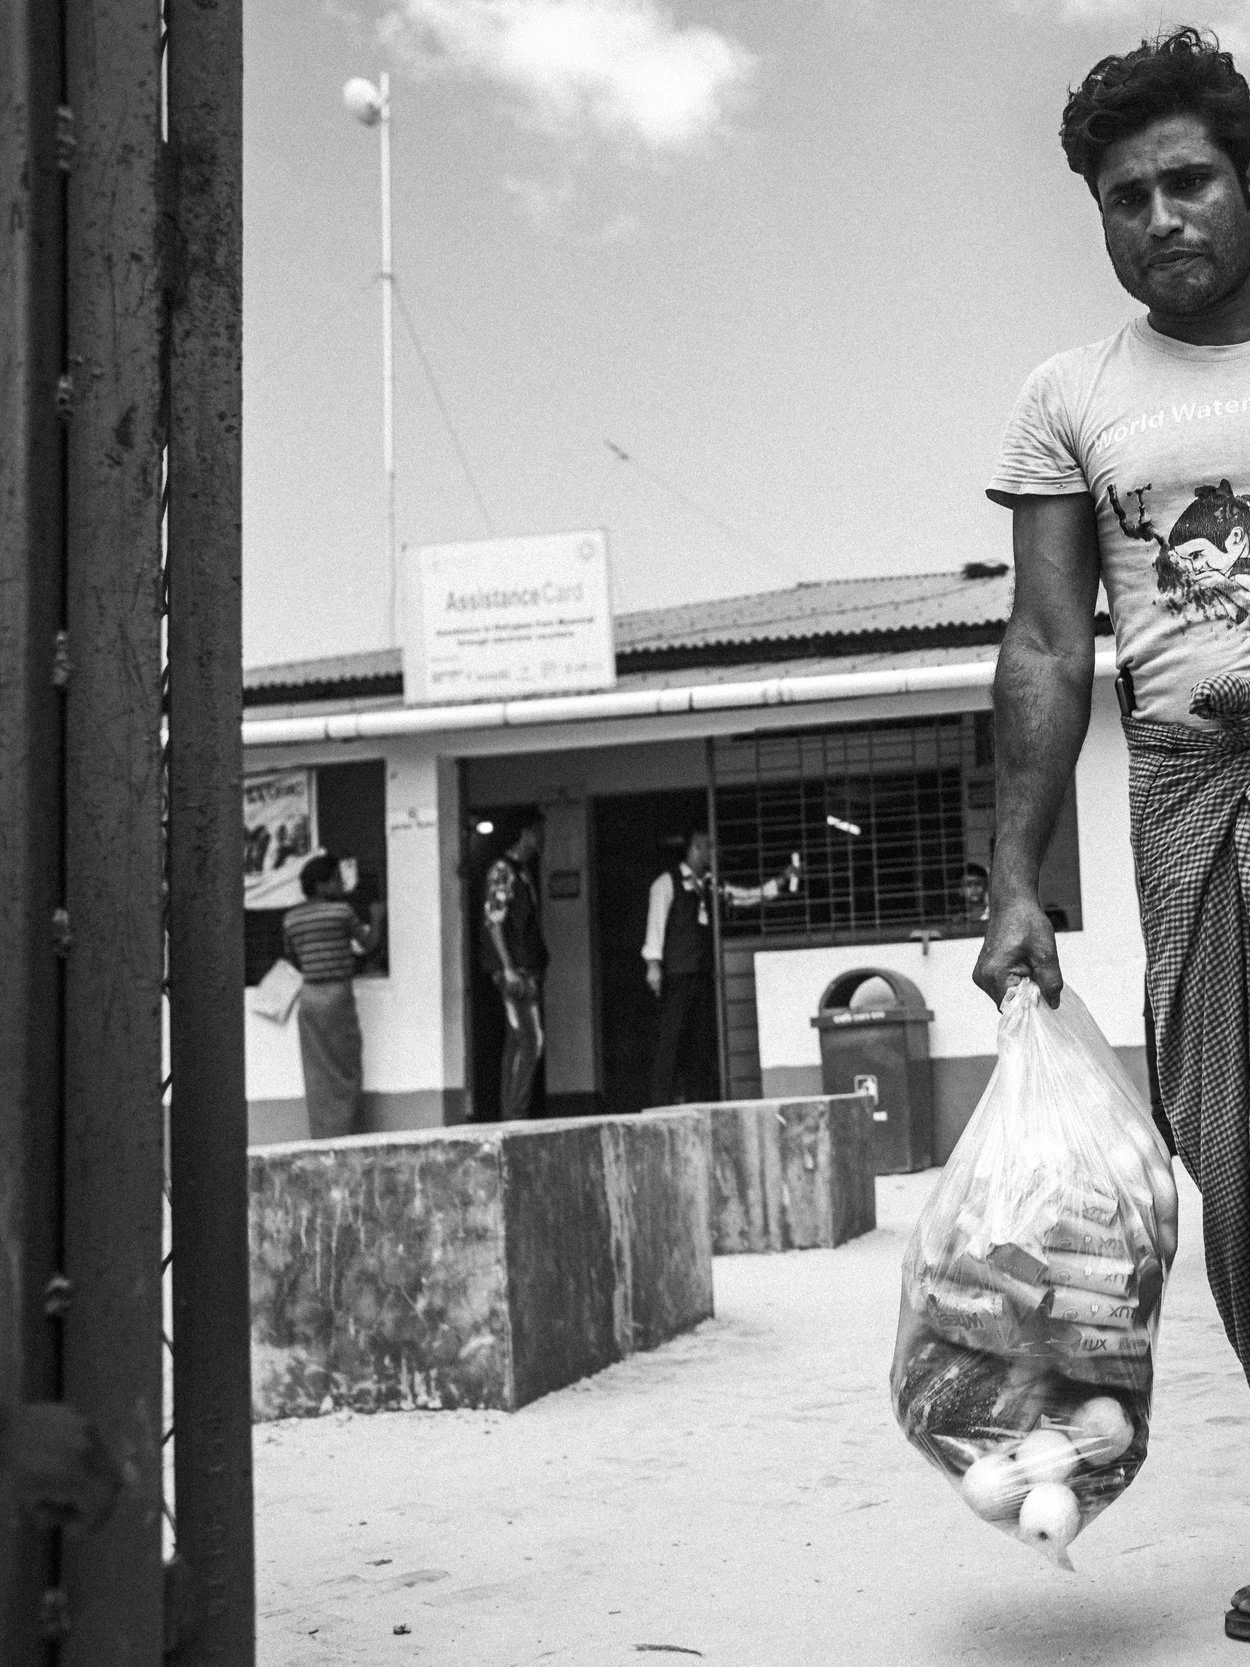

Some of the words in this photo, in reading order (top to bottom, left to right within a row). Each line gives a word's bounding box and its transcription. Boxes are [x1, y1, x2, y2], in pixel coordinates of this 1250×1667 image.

[1094, 409, 1165, 455] World
[1171, 397, 1250, 424] Water
[1083, 1338, 1107, 1352] LUX
